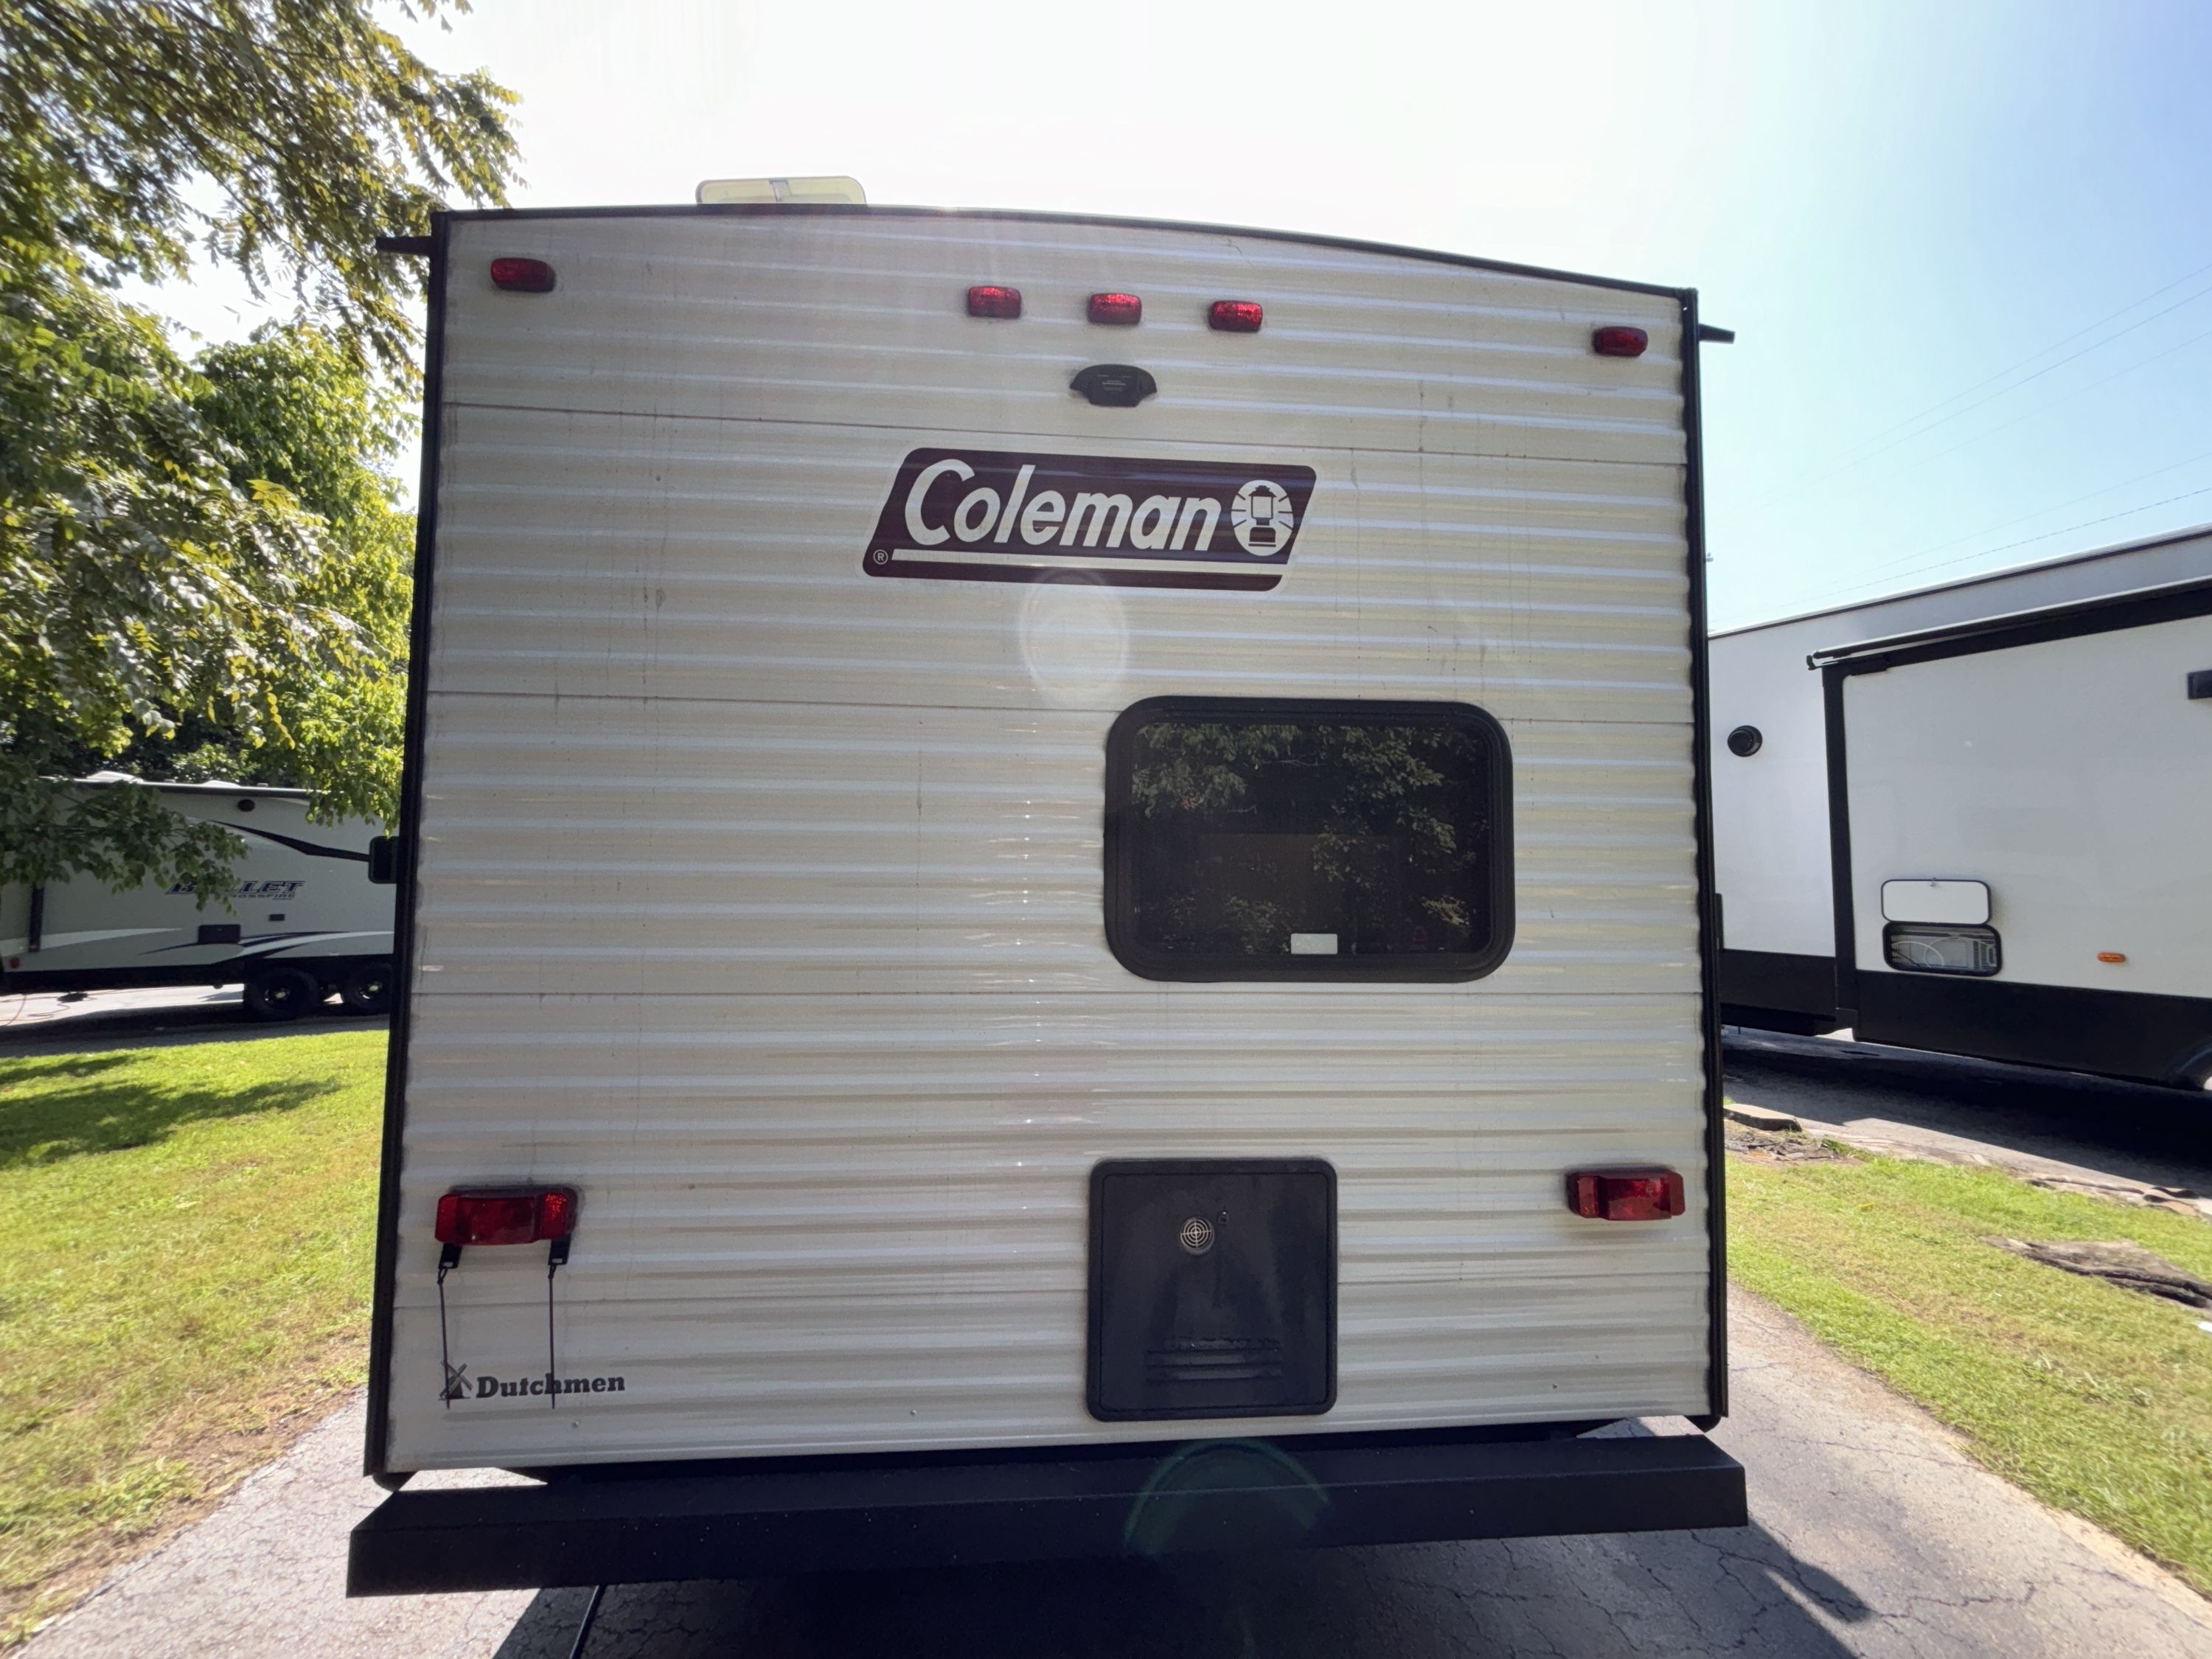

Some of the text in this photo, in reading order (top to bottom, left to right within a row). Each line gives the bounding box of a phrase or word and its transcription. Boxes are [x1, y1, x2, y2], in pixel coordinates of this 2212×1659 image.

[905, 459, 1222, 552] Coleman
[165, 880, 305, 895] BLET
[476, 1373, 625, 1399] Dutchmen
